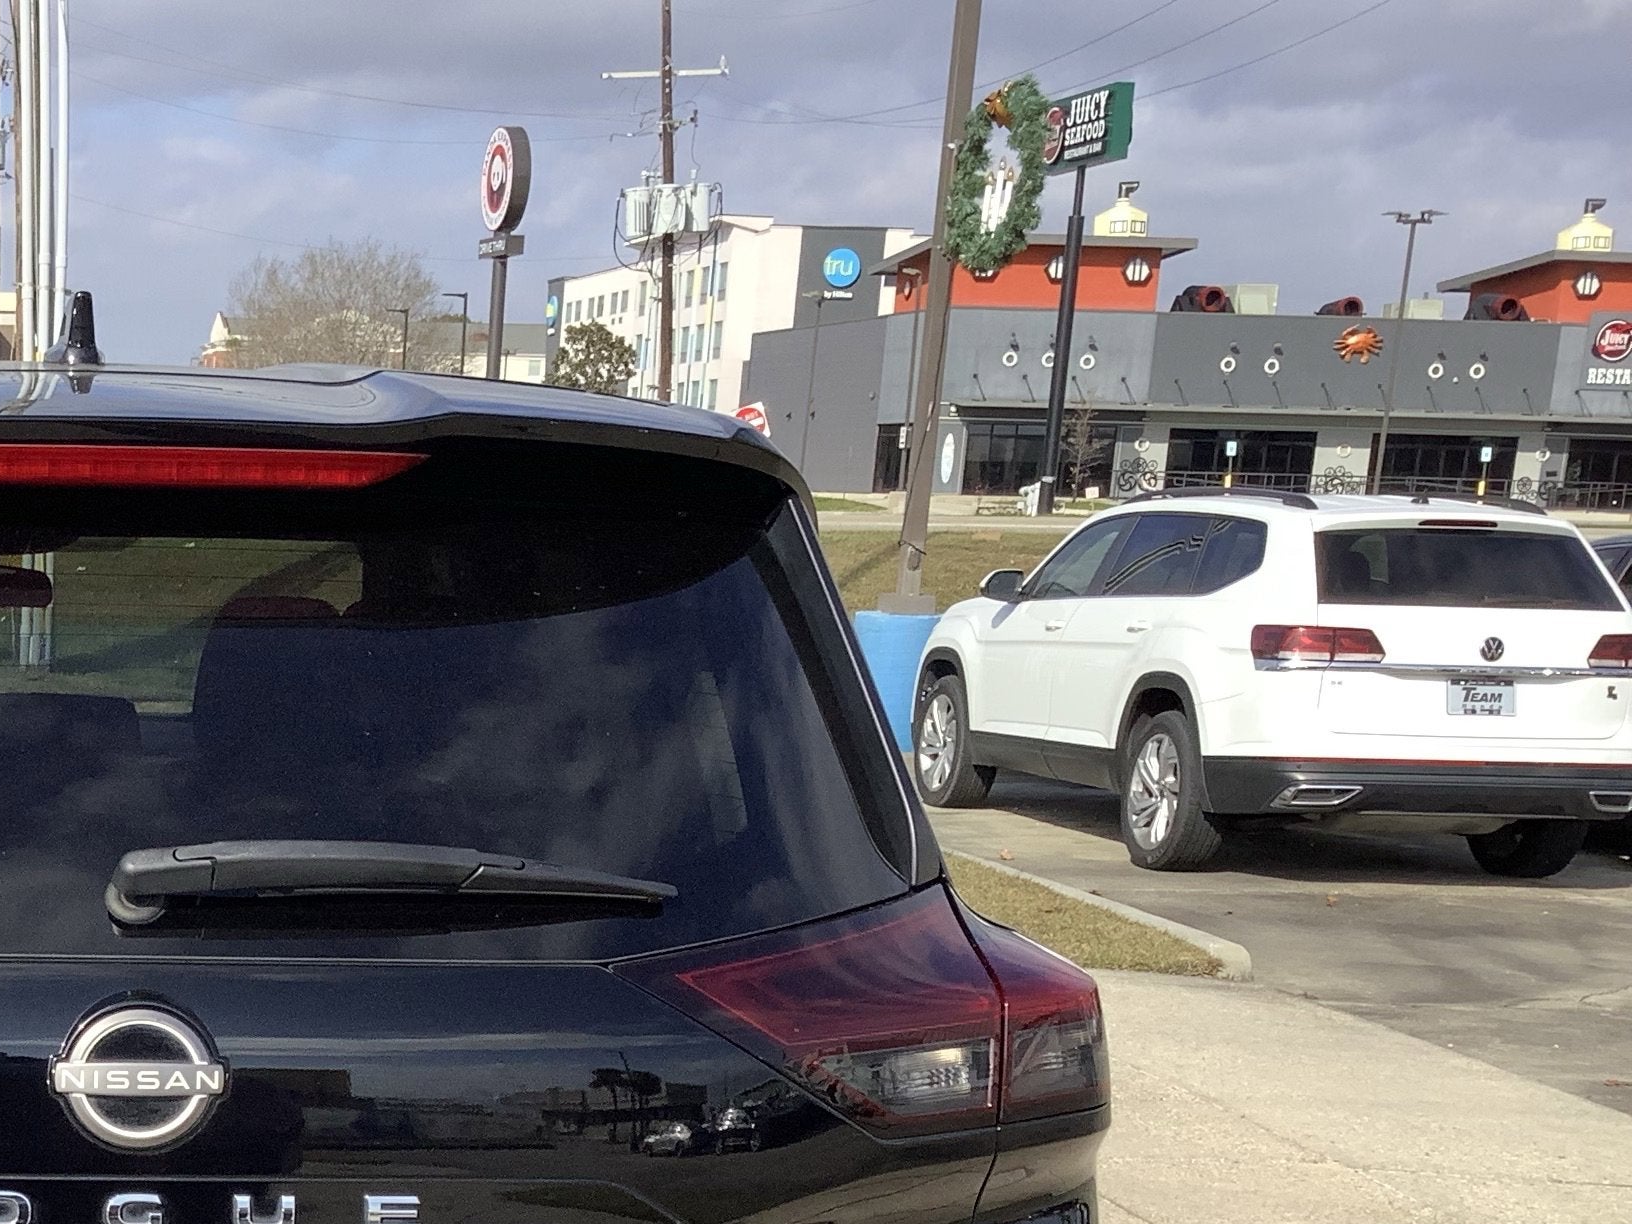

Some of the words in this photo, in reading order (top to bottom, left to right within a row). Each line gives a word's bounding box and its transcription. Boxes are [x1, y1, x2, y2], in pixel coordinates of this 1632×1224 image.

[1067, 90, 1109, 127] JUICY
[1064, 119, 1106, 146] SEAFOOD
[824, 256, 853, 276] tru
[1462, 687, 1503, 703] TEAM
[61, 1069, 219, 1090] NISSAN
